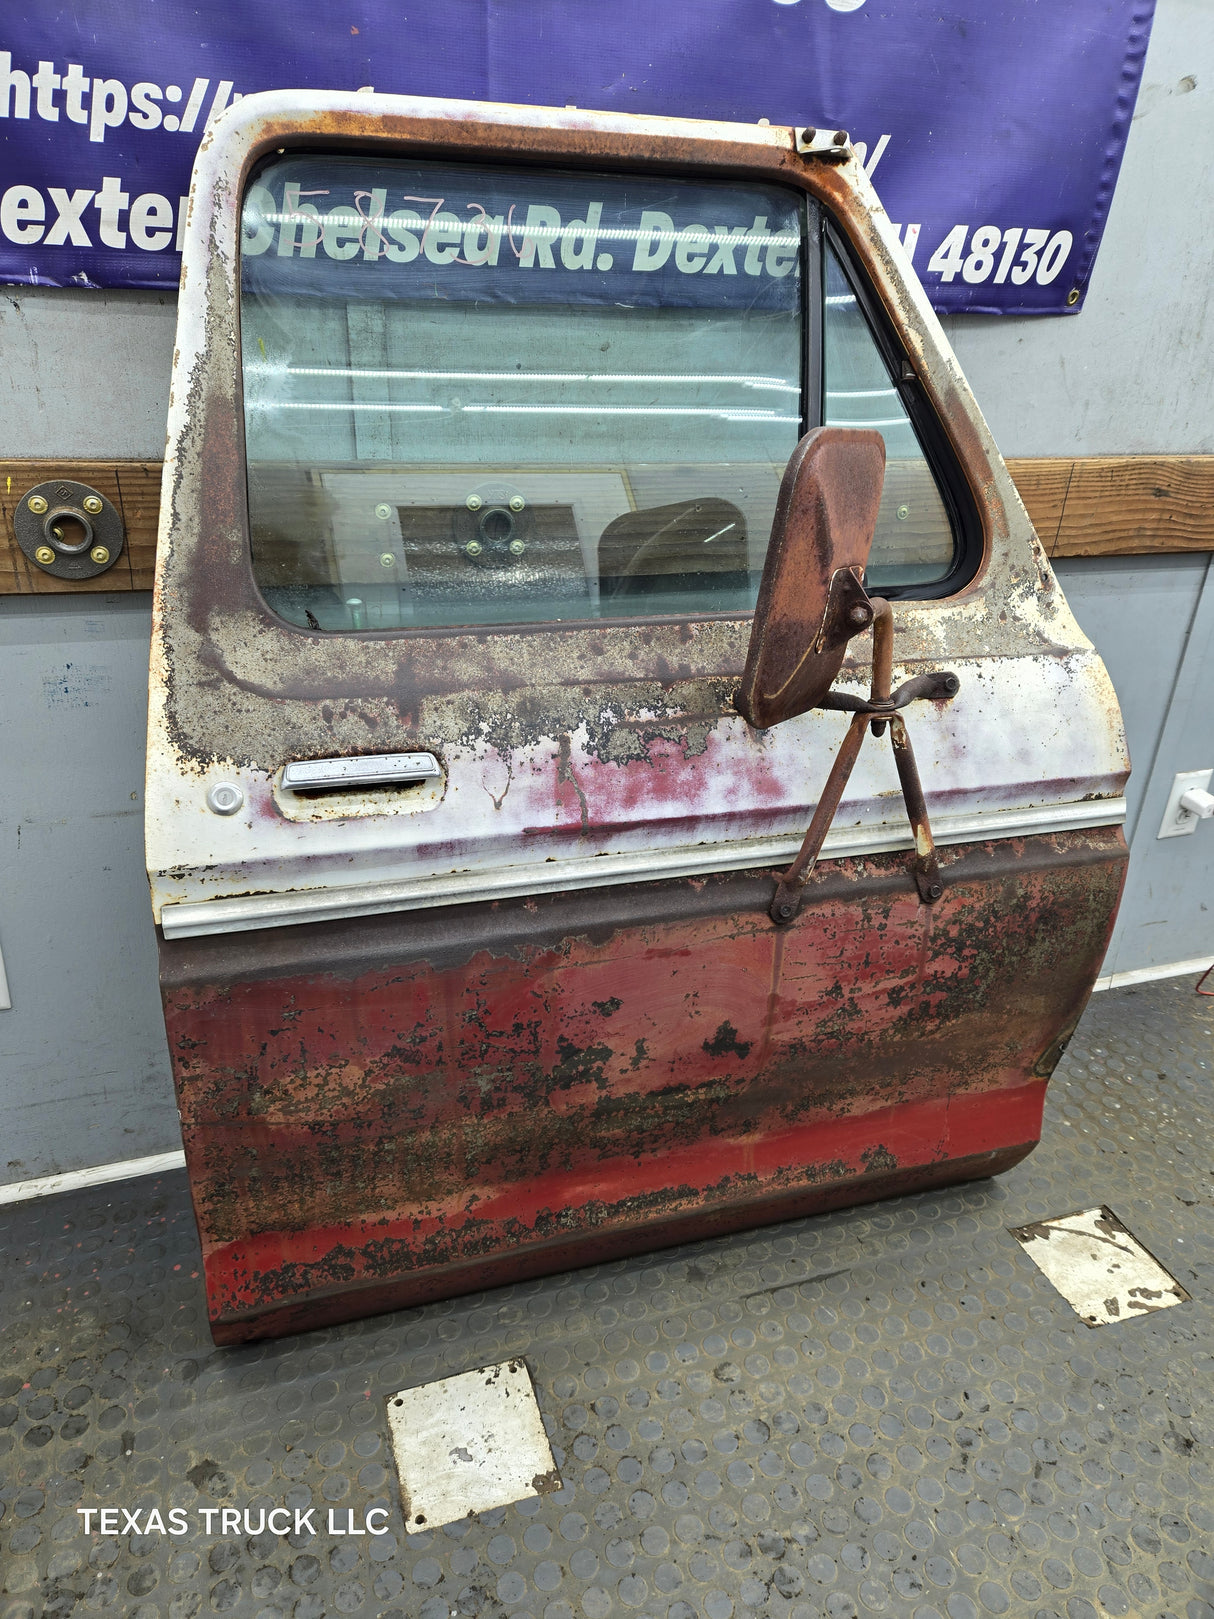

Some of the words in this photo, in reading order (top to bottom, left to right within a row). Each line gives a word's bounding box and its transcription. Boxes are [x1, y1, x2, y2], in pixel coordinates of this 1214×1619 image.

[518, 201, 614, 272] Rd.
[632, 210, 801, 278] Dexte
[927, 224, 1074, 286] 48130
